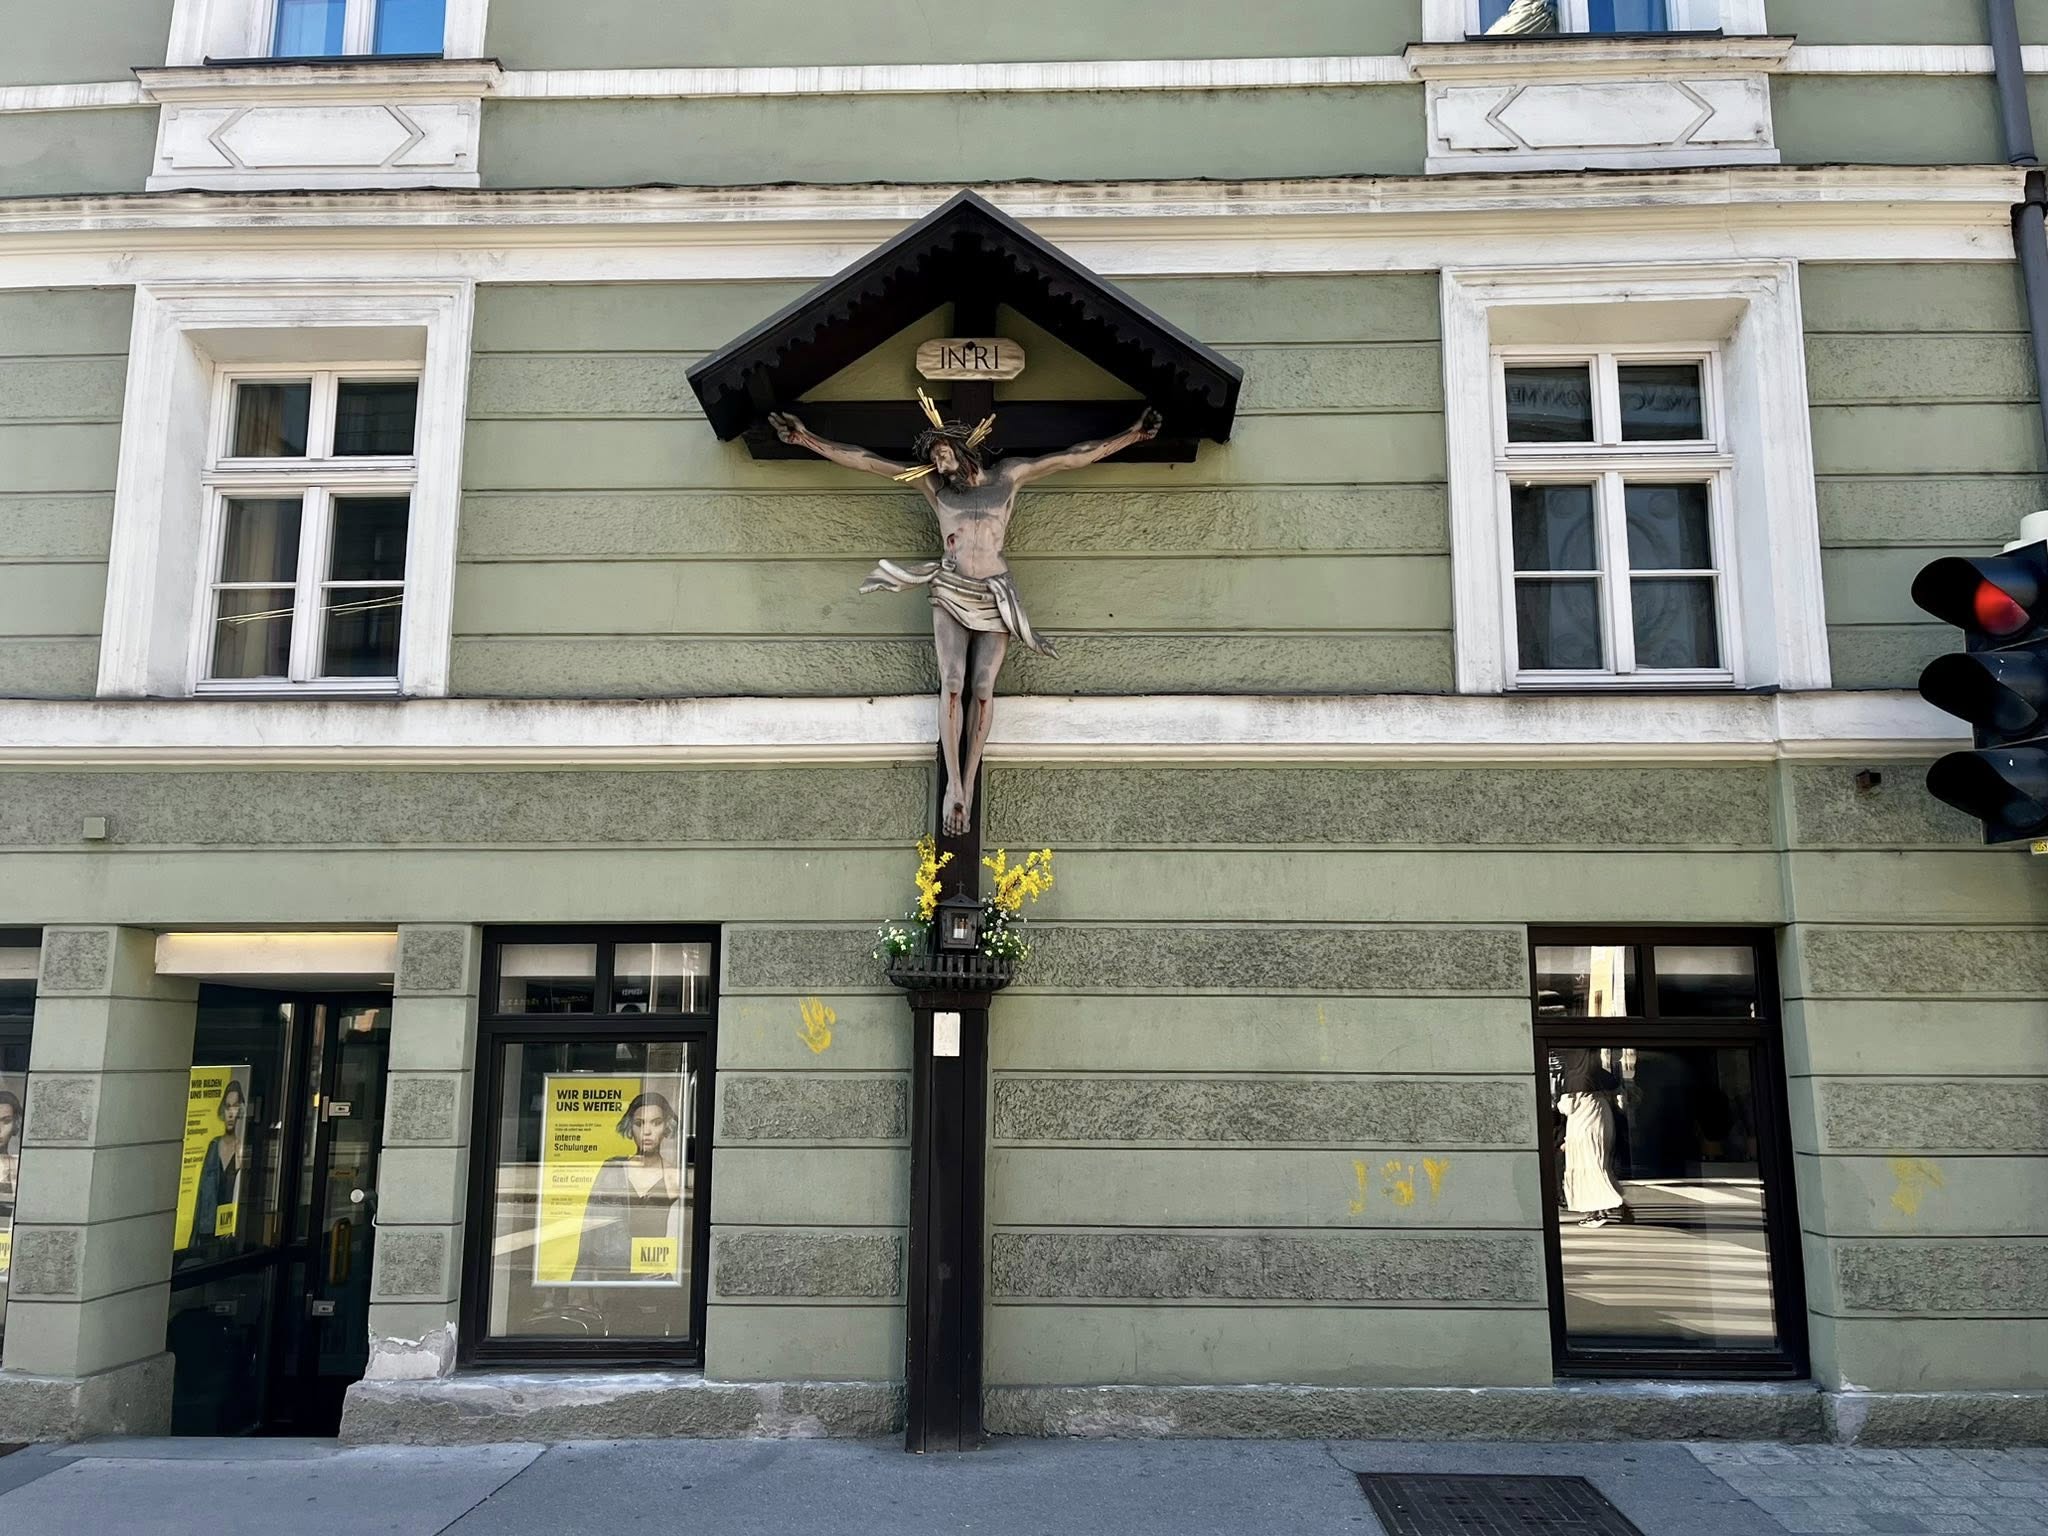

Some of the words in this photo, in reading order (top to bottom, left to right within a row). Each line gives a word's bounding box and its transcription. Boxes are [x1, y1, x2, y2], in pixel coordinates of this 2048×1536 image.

[940, 345, 999, 370] INRI
[556, 1089, 579, 1100] WIR
[582, 1089, 622, 1100] BILDEN
[556, 1101, 580, 1112] UNS
[583, 1101, 623, 1112] WEITER
[554, 1133, 581, 1142] interne
[554, 1142, 598, 1153] Schulungen
[640, 1246, 670, 1262] KLIPP
